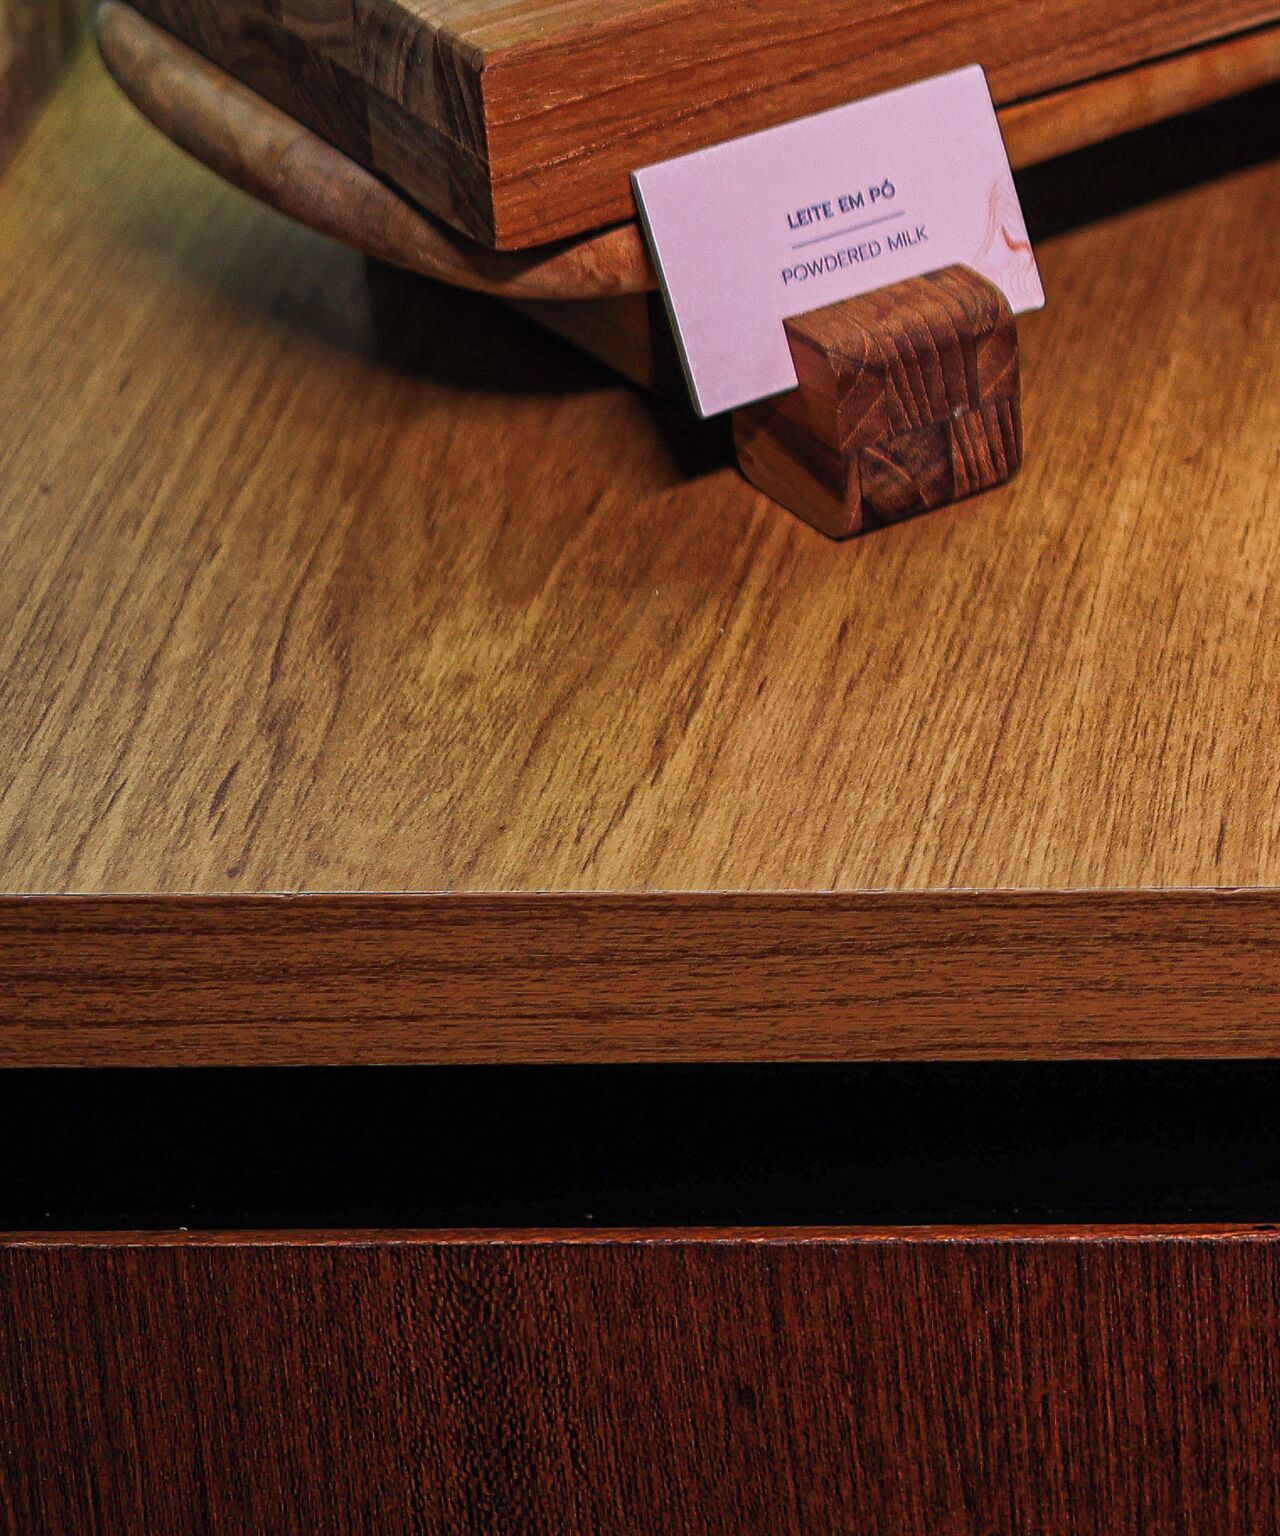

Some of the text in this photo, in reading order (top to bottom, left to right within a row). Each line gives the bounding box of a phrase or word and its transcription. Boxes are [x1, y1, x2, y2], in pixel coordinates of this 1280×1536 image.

[787, 178, 896, 229] LEITE EM PÓ
[781, 224, 929, 285] POWDERED MILK
